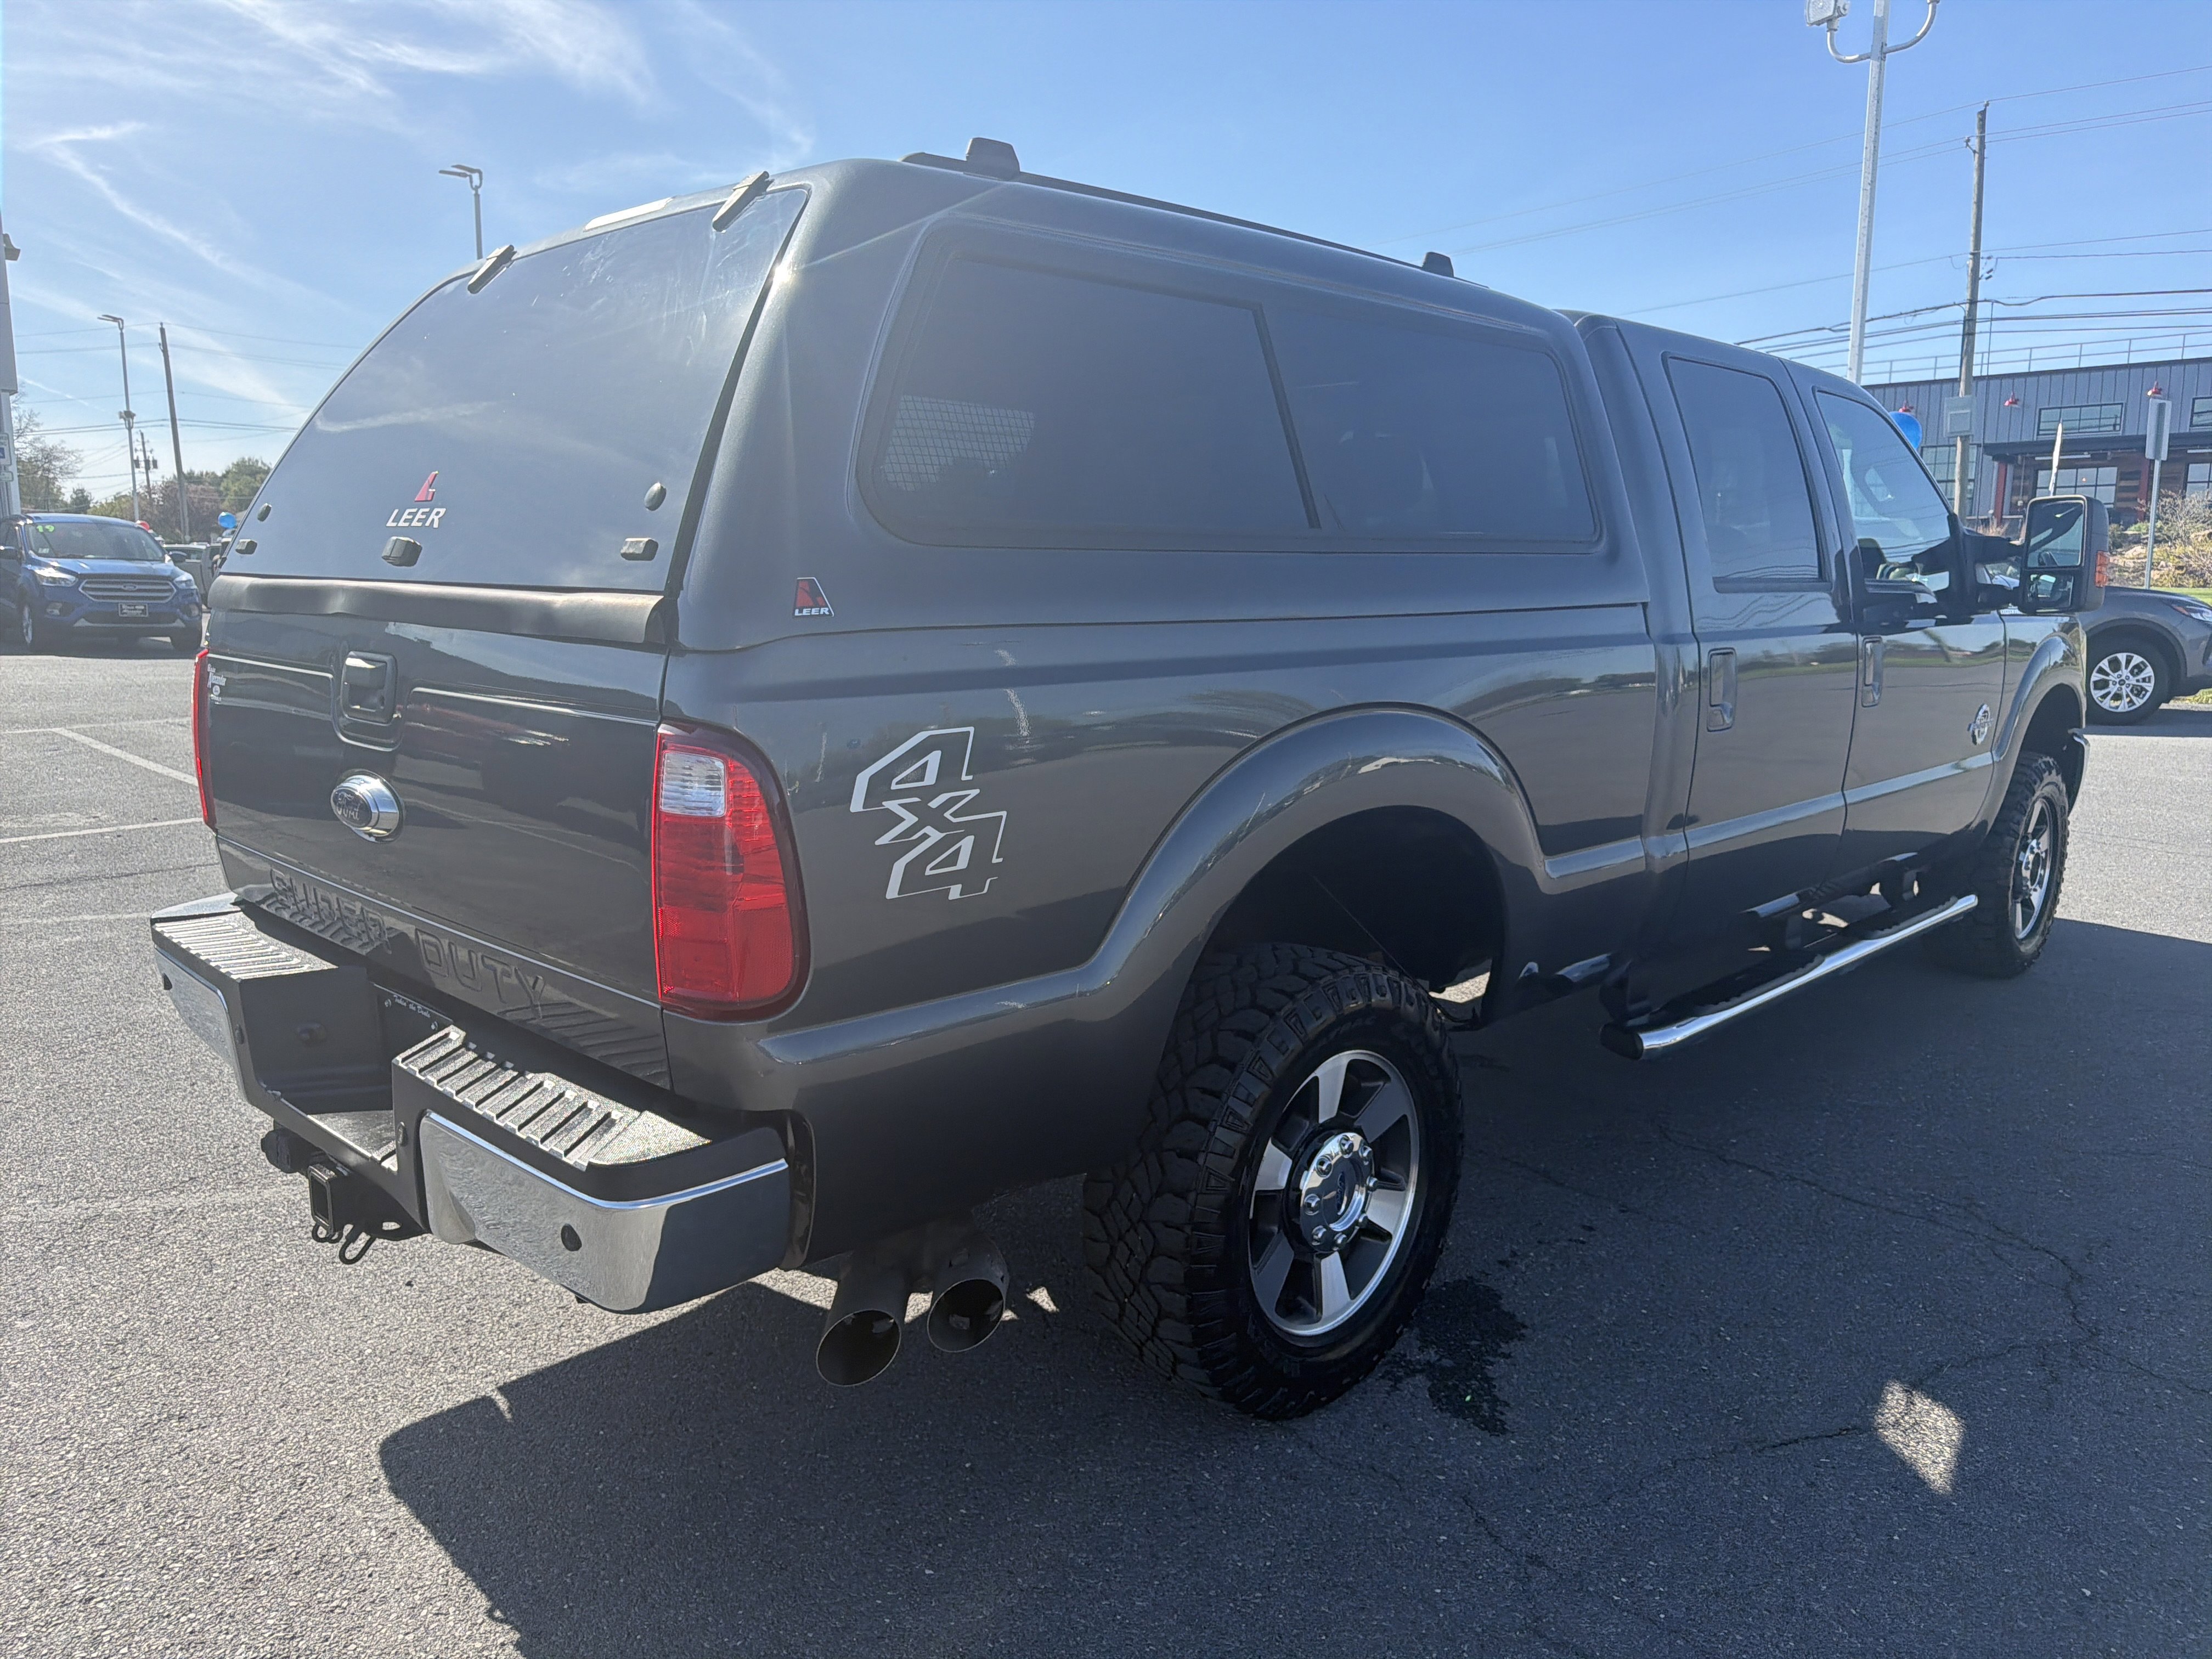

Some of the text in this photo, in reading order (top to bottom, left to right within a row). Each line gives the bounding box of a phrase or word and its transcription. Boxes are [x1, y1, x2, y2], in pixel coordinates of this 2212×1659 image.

[386, 507, 447, 528] LEER
[794, 607, 830, 616] LEER
[270, 868, 546, 1019] SUPER DUTY
